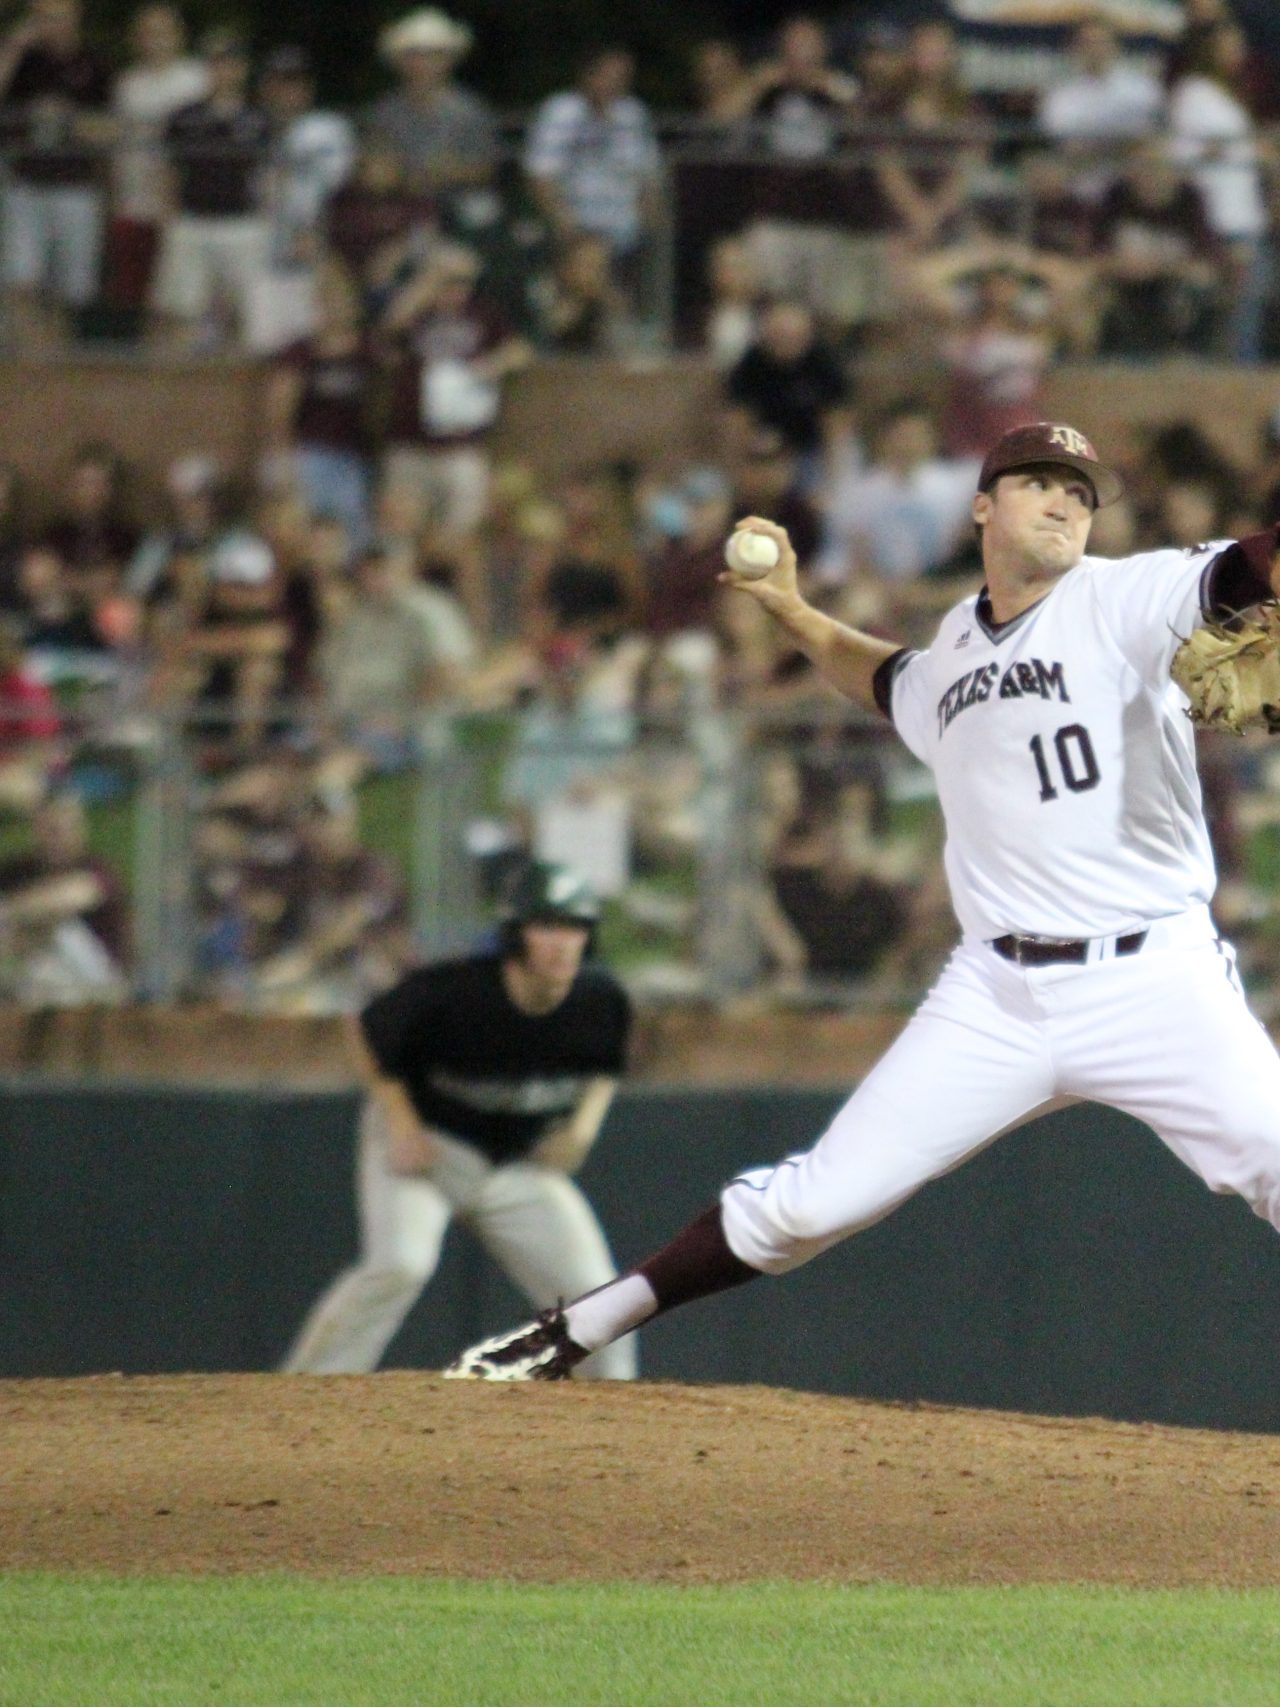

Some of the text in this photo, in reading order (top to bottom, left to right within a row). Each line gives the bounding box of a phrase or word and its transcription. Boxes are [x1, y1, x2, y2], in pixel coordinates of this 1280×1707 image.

[937, 657, 1073, 742] TEXAS A&M
[1029, 722, 1101, 803] 10
